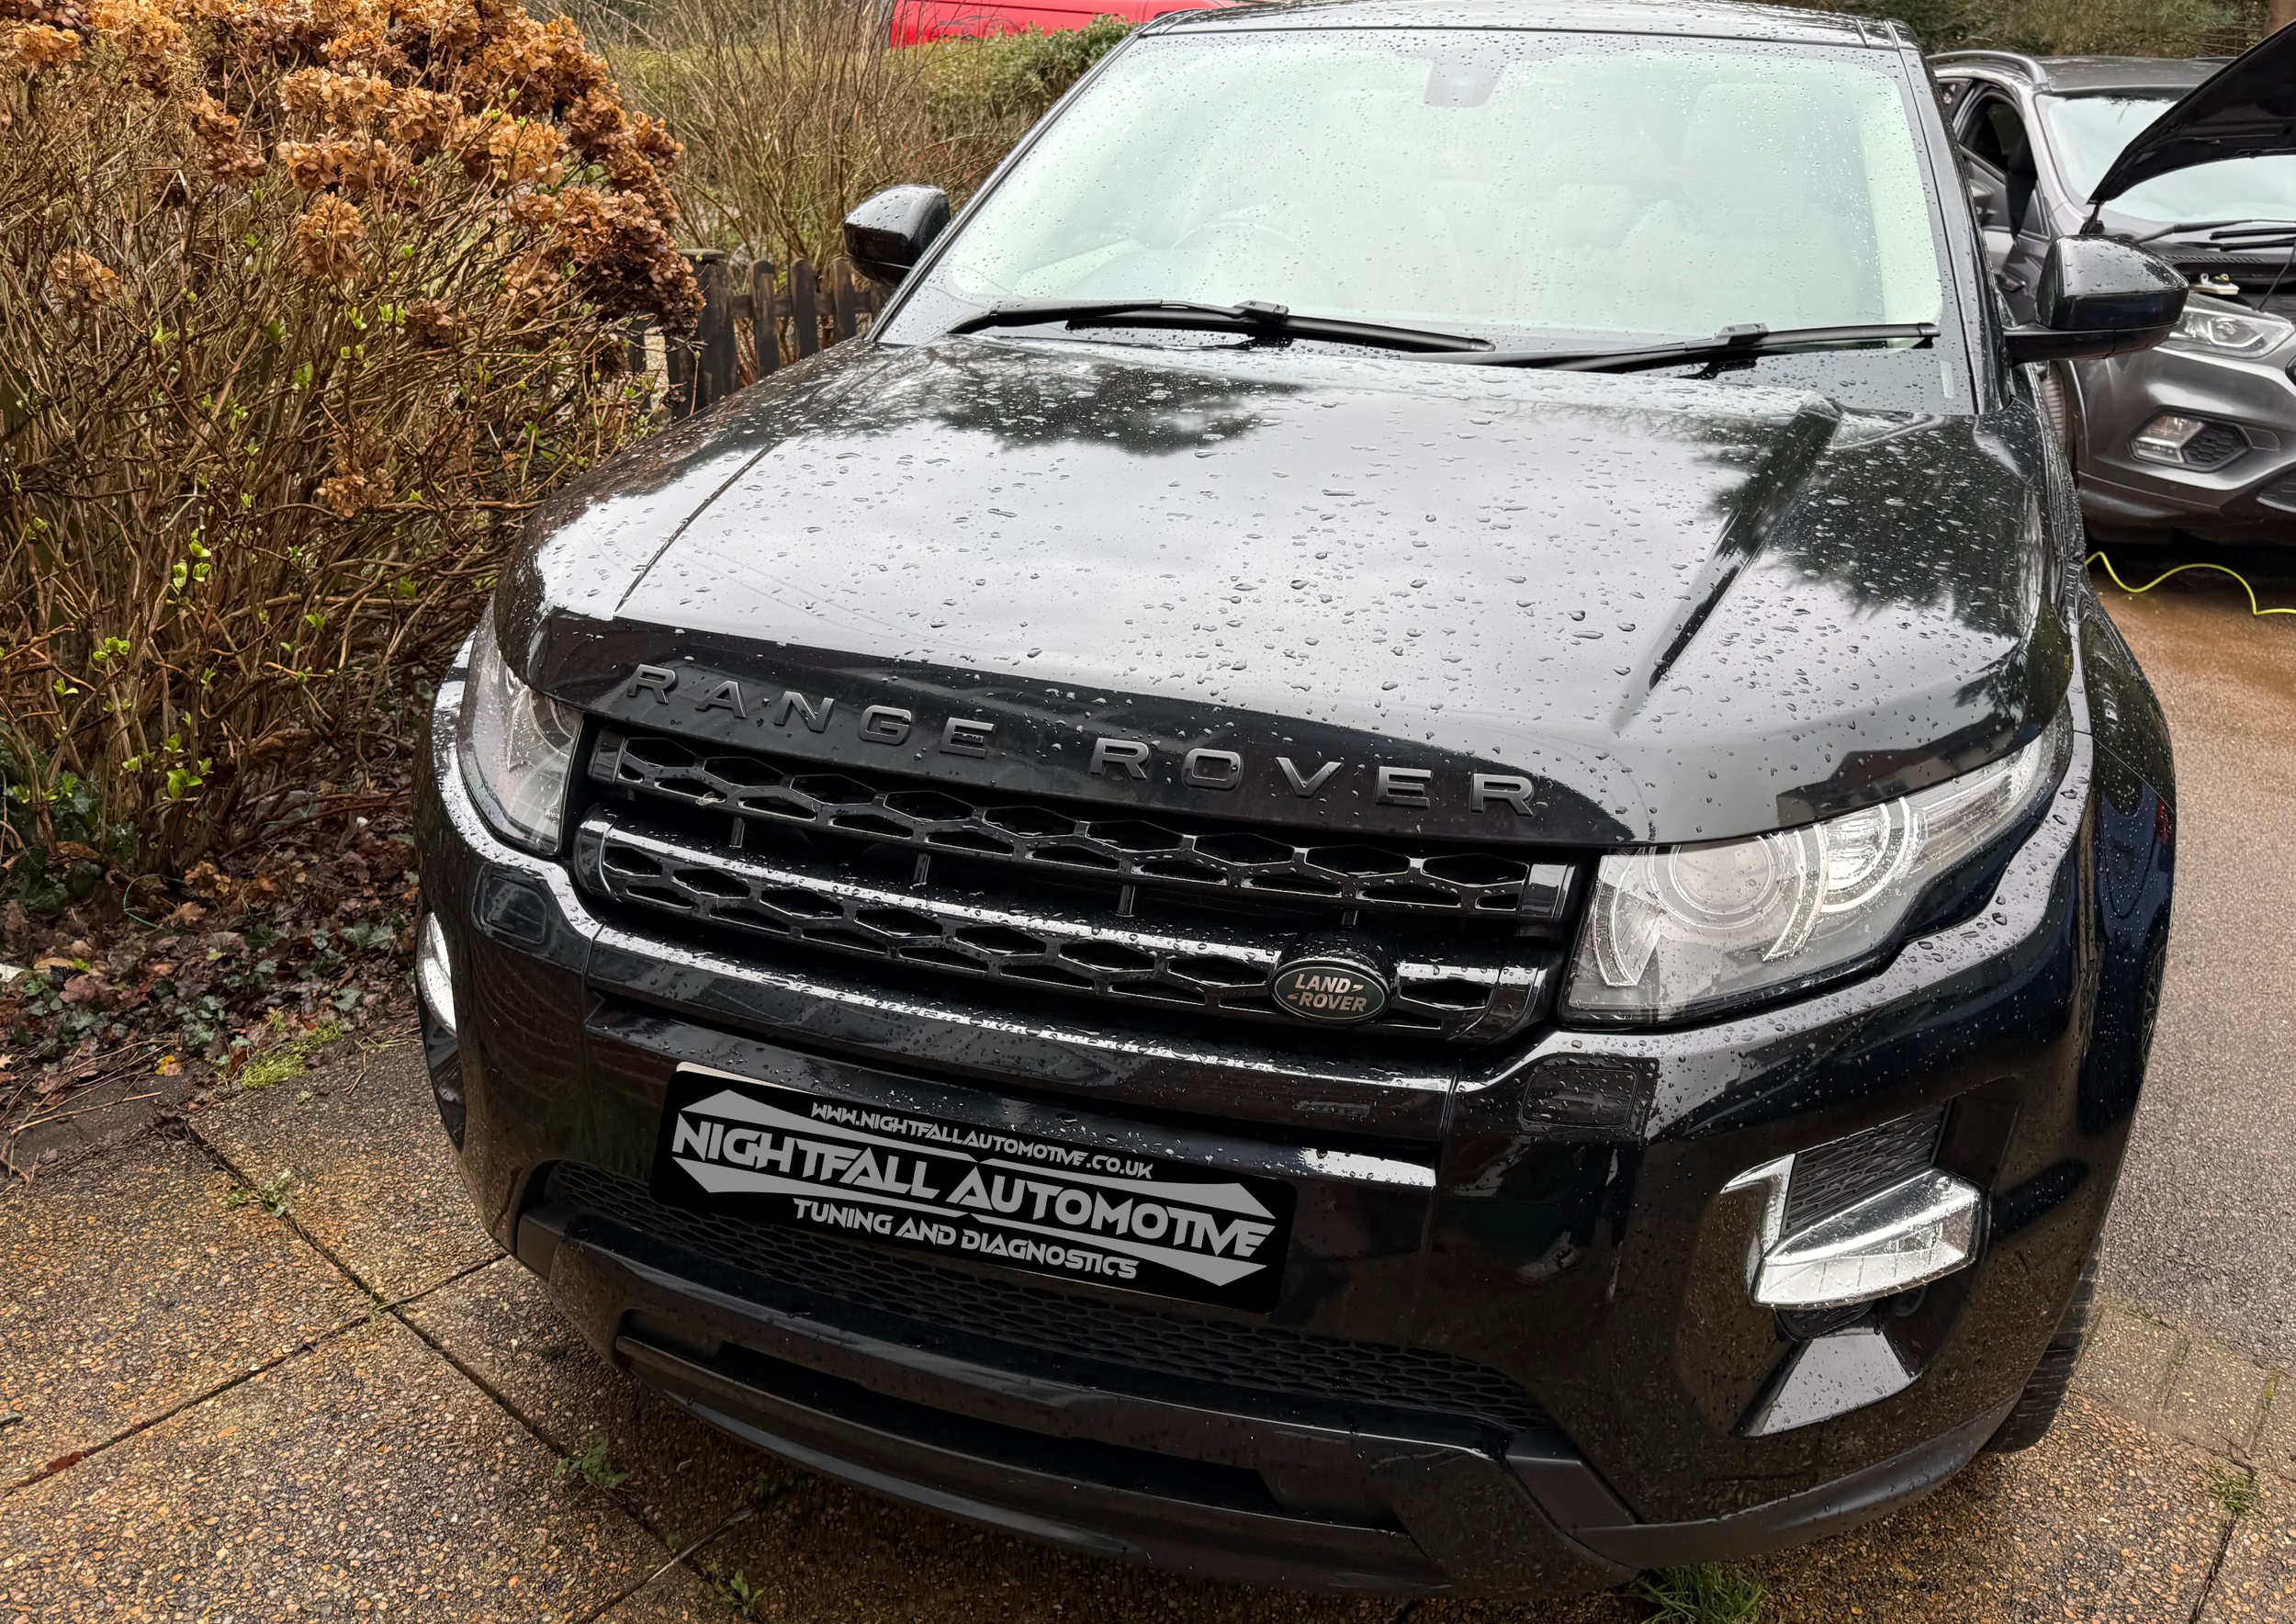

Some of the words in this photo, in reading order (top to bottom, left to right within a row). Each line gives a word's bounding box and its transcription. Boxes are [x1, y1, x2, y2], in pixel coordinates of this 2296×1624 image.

[626, 663, 996, 759] RANGE
[1089, 737, 1534, 818] ROVER
[1294, 973, 1352, 994] LAND
[1298, 991, 1368, 1012] ROVER
